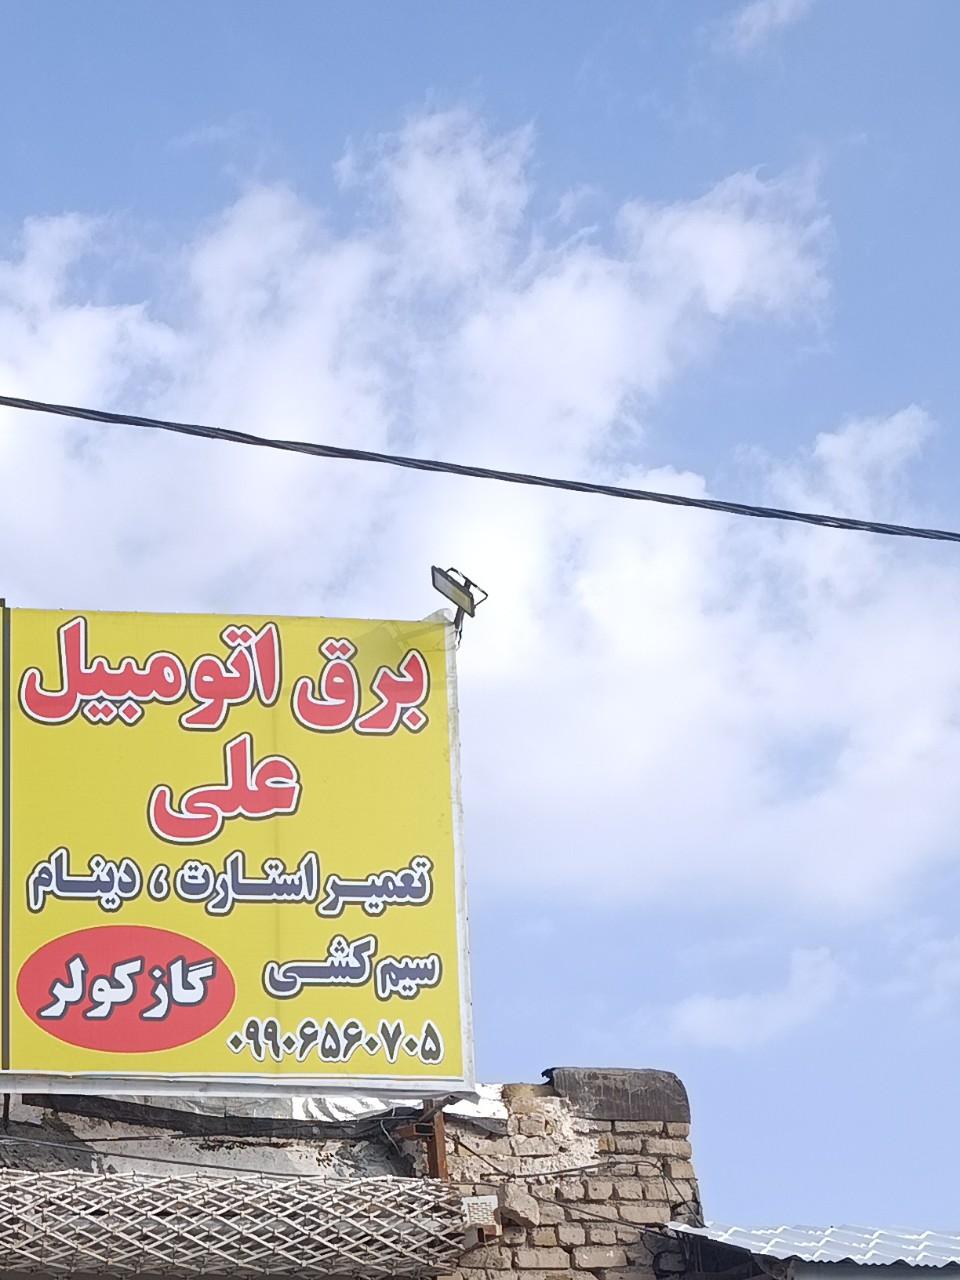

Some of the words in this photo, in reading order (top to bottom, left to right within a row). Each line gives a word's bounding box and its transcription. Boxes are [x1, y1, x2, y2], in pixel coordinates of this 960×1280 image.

[19, 616, 281, 731] اتومبیل
[292, 637, 431, 733] برق
[148, 733, 303, 845] علی
[27, 847, 142, 913] دینام
[176, 850, 318, 914] استارت
[318, 855, 434, 916] تعمیر
[37, 953, 142, 1022] کولر
[139, 956, 216, 1022] گاز
[262, 935, 377, 997] کشی
[376, 953, 440, 1000] سیم
[226, 1017, 445, 1064] ۰۹۹۰۶۵۶۰۷۰۵
